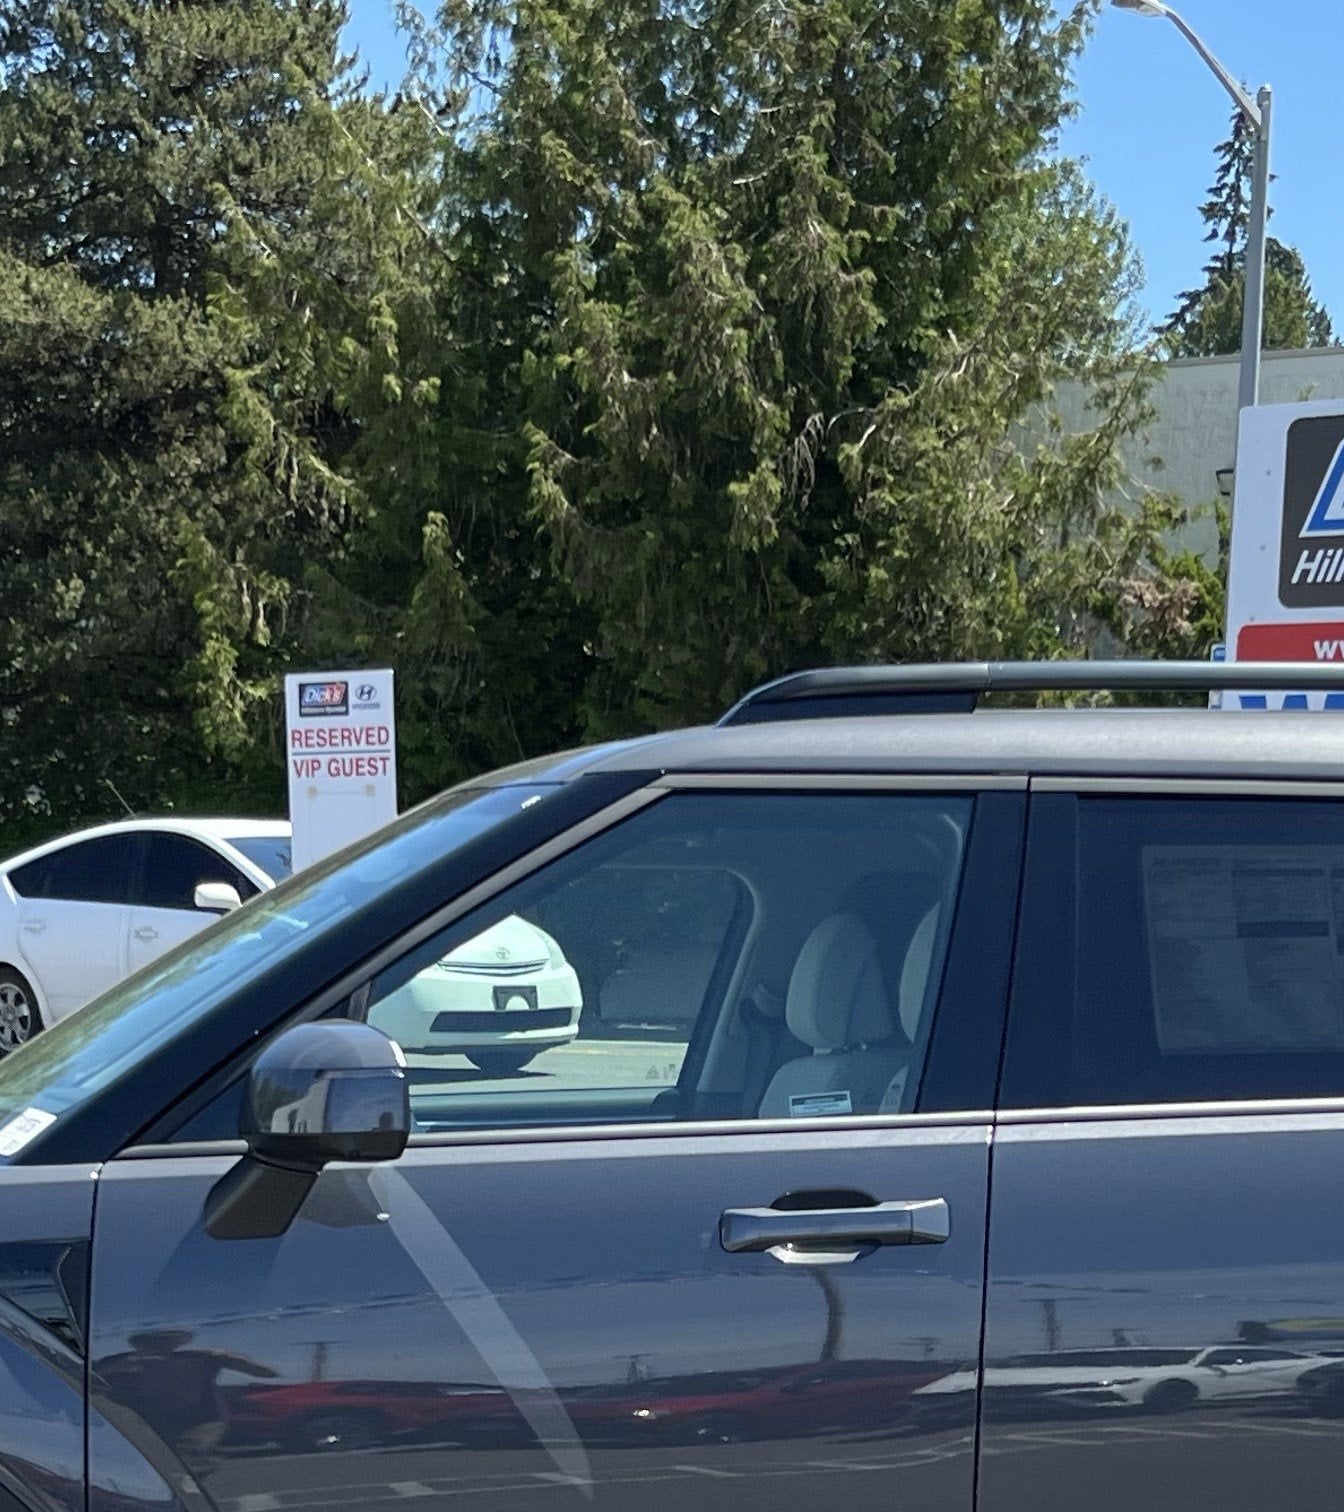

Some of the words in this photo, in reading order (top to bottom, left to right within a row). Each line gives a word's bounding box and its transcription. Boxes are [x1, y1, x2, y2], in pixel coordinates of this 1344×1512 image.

[291, 726, 389, 748] RESERVED
[293, 758, 321, 778] VIP
[328, 757, 390, 777] GUEST
